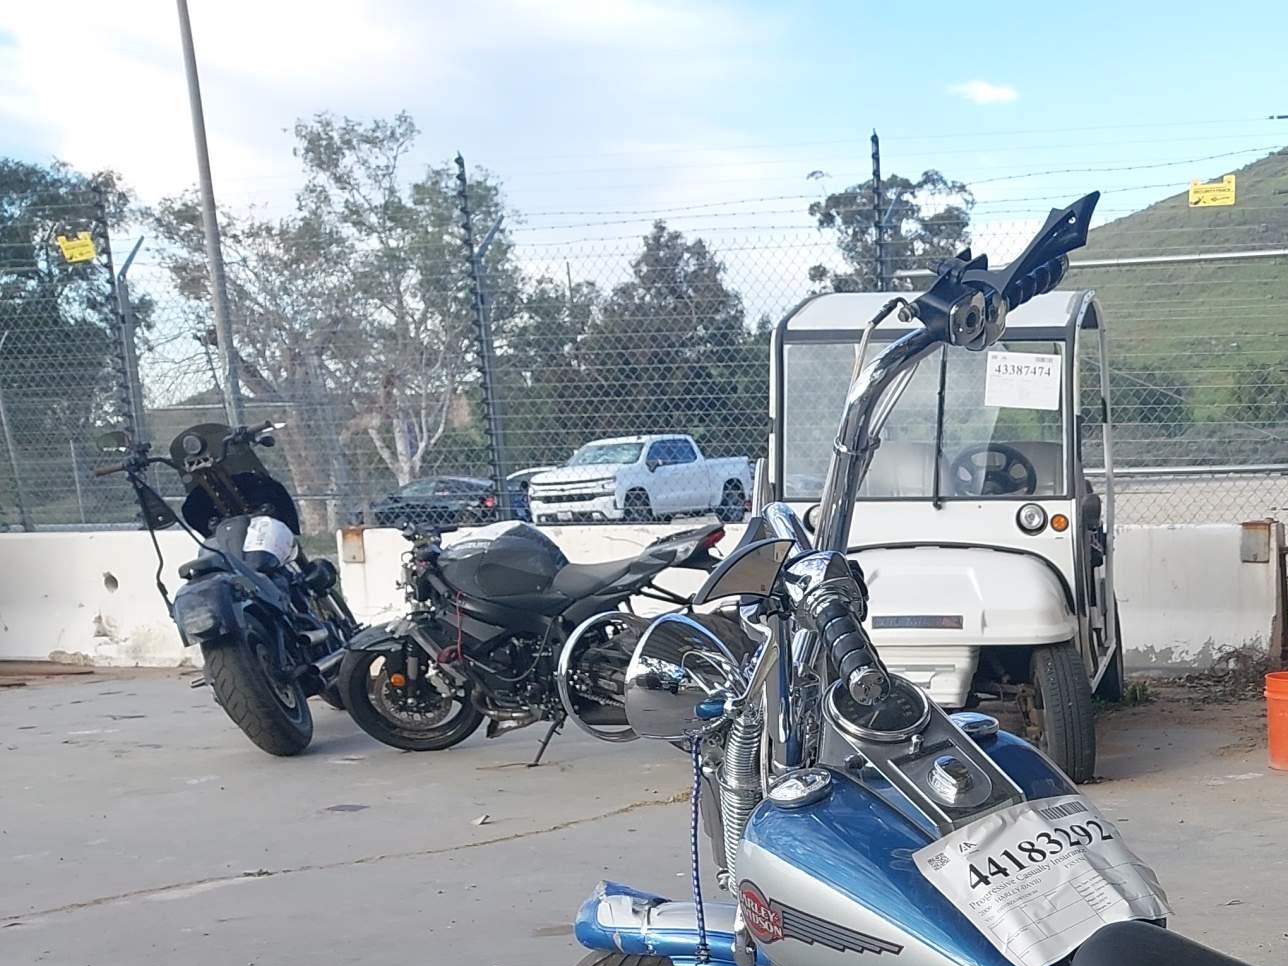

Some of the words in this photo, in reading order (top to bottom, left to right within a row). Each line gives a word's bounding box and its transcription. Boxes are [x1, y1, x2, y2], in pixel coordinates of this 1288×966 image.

[994, 364, 1051, 377] 43387474
[969, 820, 1115, 889] 44183292
[968, 878, 1016, 910] Progressive
[1015, 863, 1051, 881] Casualty
